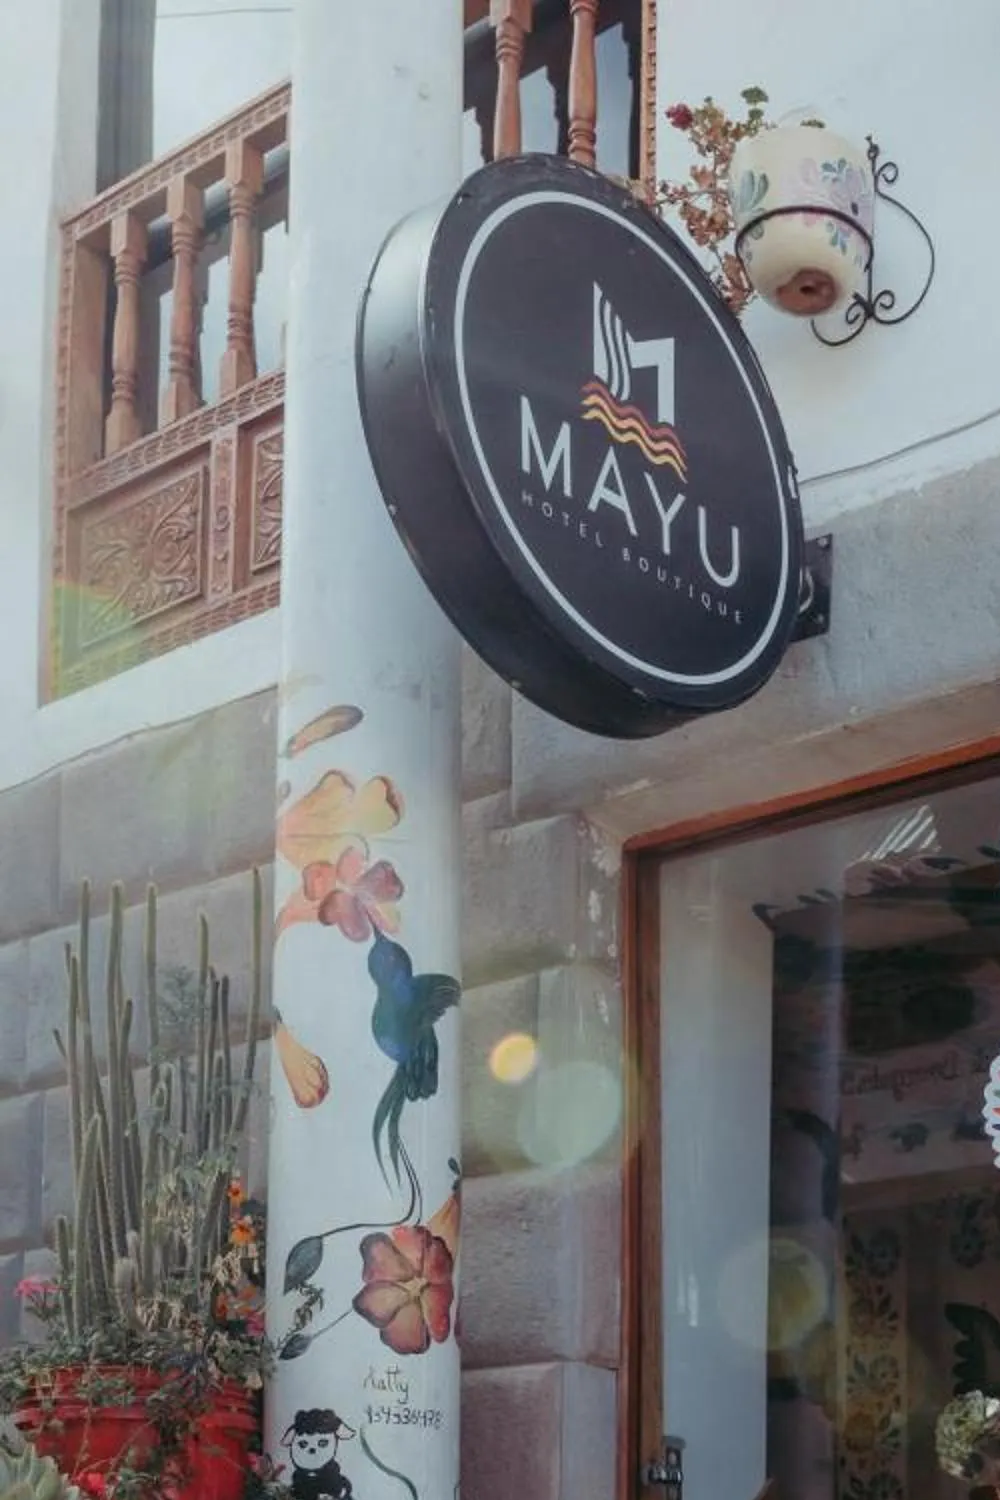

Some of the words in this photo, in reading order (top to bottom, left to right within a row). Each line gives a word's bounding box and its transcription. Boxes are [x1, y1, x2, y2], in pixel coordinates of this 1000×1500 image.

[521, 396, 740, 588] MAYU
[522, 489, 604, 548] HOTEL
[622, 547, 742, 625] BOUTIQUE
